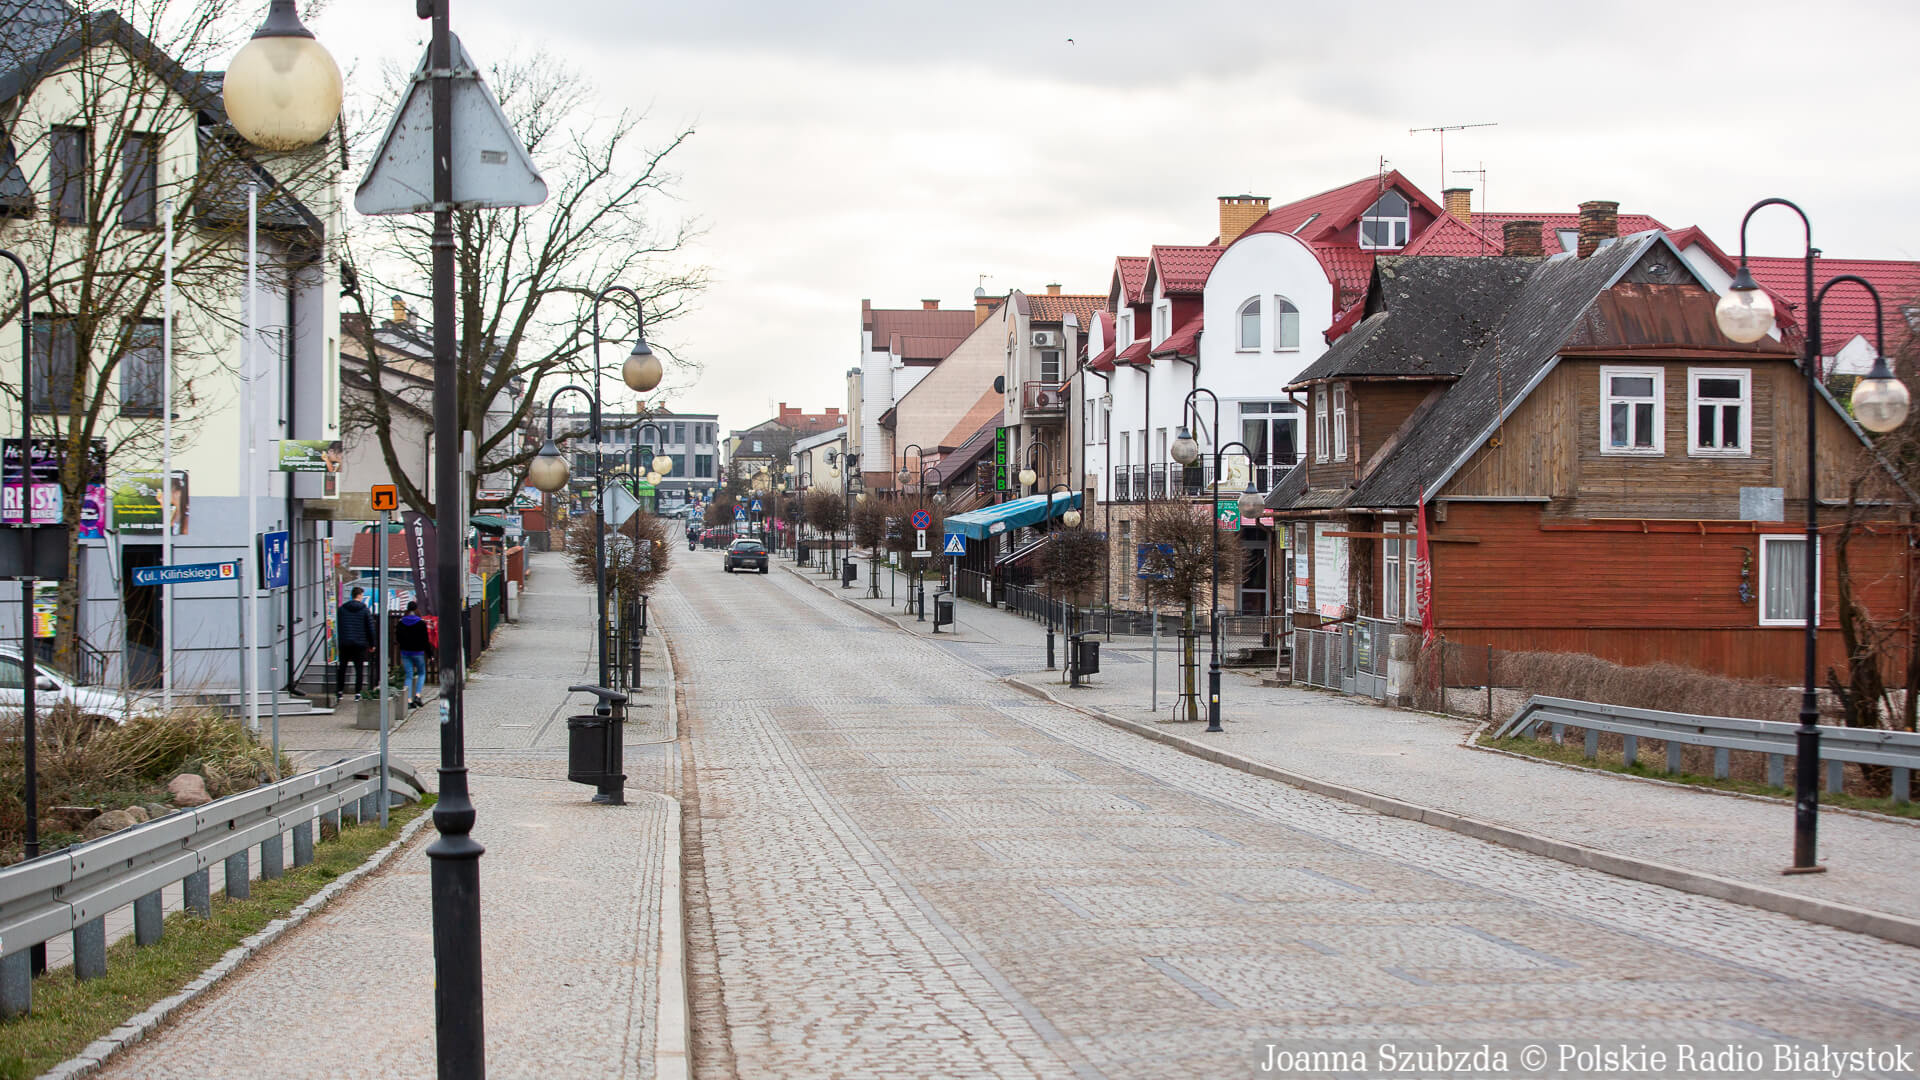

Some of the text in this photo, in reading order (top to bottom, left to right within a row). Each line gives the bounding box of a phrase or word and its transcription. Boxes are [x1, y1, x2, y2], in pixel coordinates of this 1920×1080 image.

[997, 428, 1005, 489] KEBAB
[143, 567, 218, 581] ul. Kilińskiego
